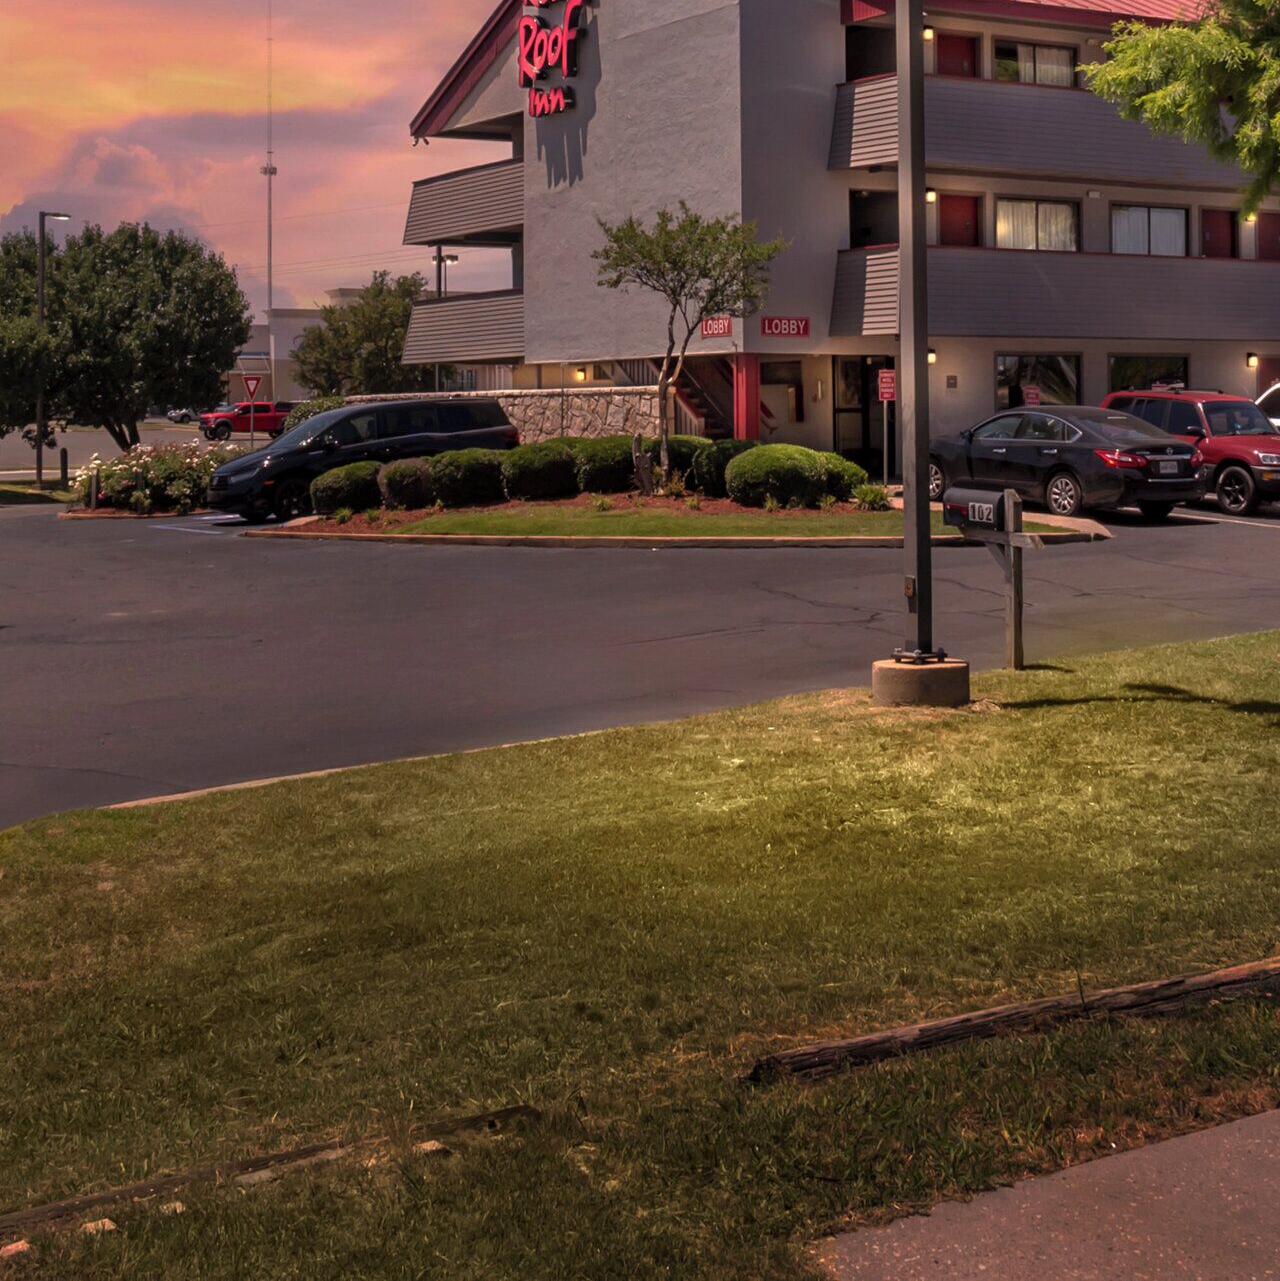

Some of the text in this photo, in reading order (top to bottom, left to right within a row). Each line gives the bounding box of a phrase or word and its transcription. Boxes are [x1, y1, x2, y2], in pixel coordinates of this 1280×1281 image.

[702, 319, 729, 335] LOBBY
[764, 319, 806, 334] LOBBY
[970, 504, 992, 522] 102
